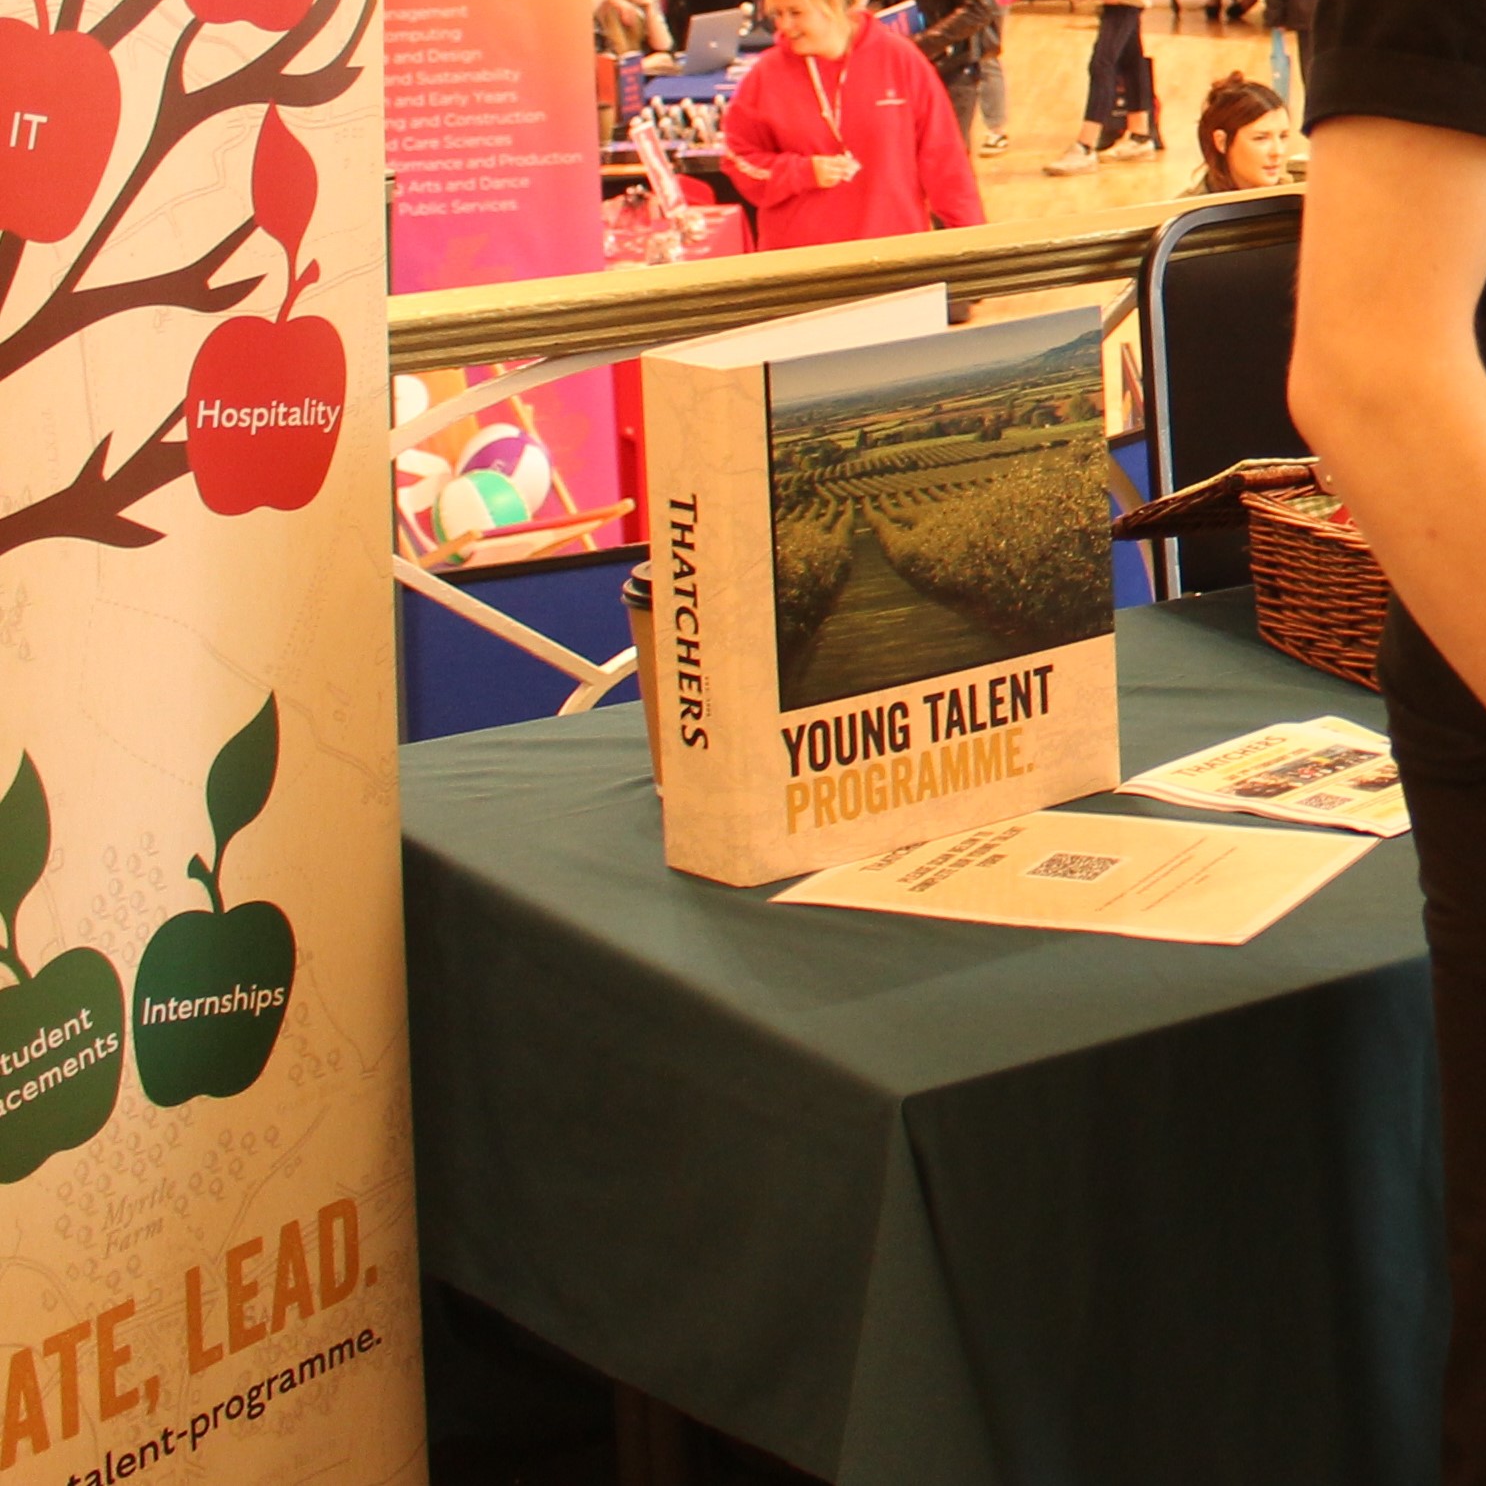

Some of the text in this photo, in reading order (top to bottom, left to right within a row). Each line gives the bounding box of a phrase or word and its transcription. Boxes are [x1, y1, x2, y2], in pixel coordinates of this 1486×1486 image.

[427, 48, 483, 64] Design
[416, 69, 521, 86] Sustainability
[428, 91, 469, 107] Early
[473, 91, 519, 104] Years
[10, 111, 48, 150] IT
[410, 115, 441, 129] and
[444, 111, 546, 127] Construction
[401, 136, 440, 151] Care
[444, 135, 513, 150] Sciences
[499, 151, 583, 167] Production
[479, 176, 531, 191] Dance
[398, 199, 518, 217] Public Services
[196, 399, 341, 434] Hospitality
[669, 493, 709, 751] THATCHERS
[781, 664, 1054, 778] YOUNG TALENT
[1170, 735, 1287, 778] THATCHERS
[785, 726, 1035, 835] PROGRAMME.
[141, 984, 285, 1026] Internships
[0, 1198, 378, 1472] ATE, LEAD.
